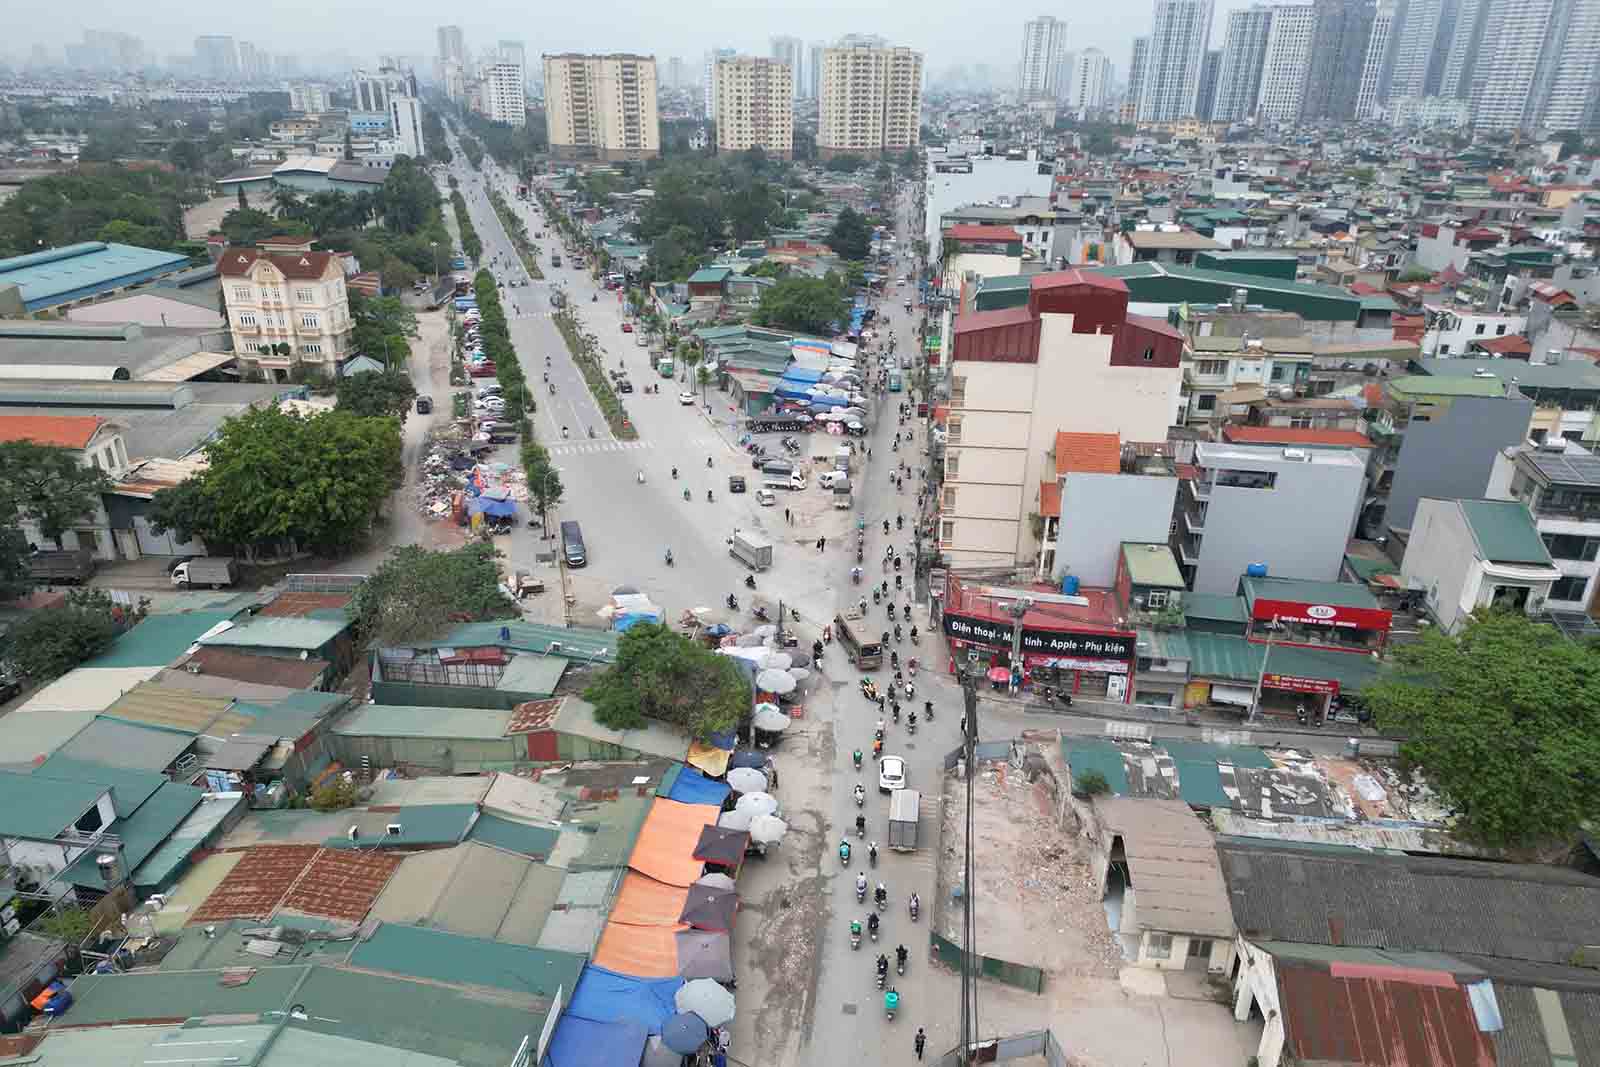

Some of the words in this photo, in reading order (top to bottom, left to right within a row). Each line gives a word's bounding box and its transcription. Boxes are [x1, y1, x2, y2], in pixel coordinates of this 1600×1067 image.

[952, 620, 971, 633] Điện
[974, 626, 996, 640] thoại
[1024, 636, 1042, 647] tính
[1050, 639, 1077, 651] Apple
[1085, 641, 1102, 653] Phụ
[1104, 643, 1125, 655] kiện
